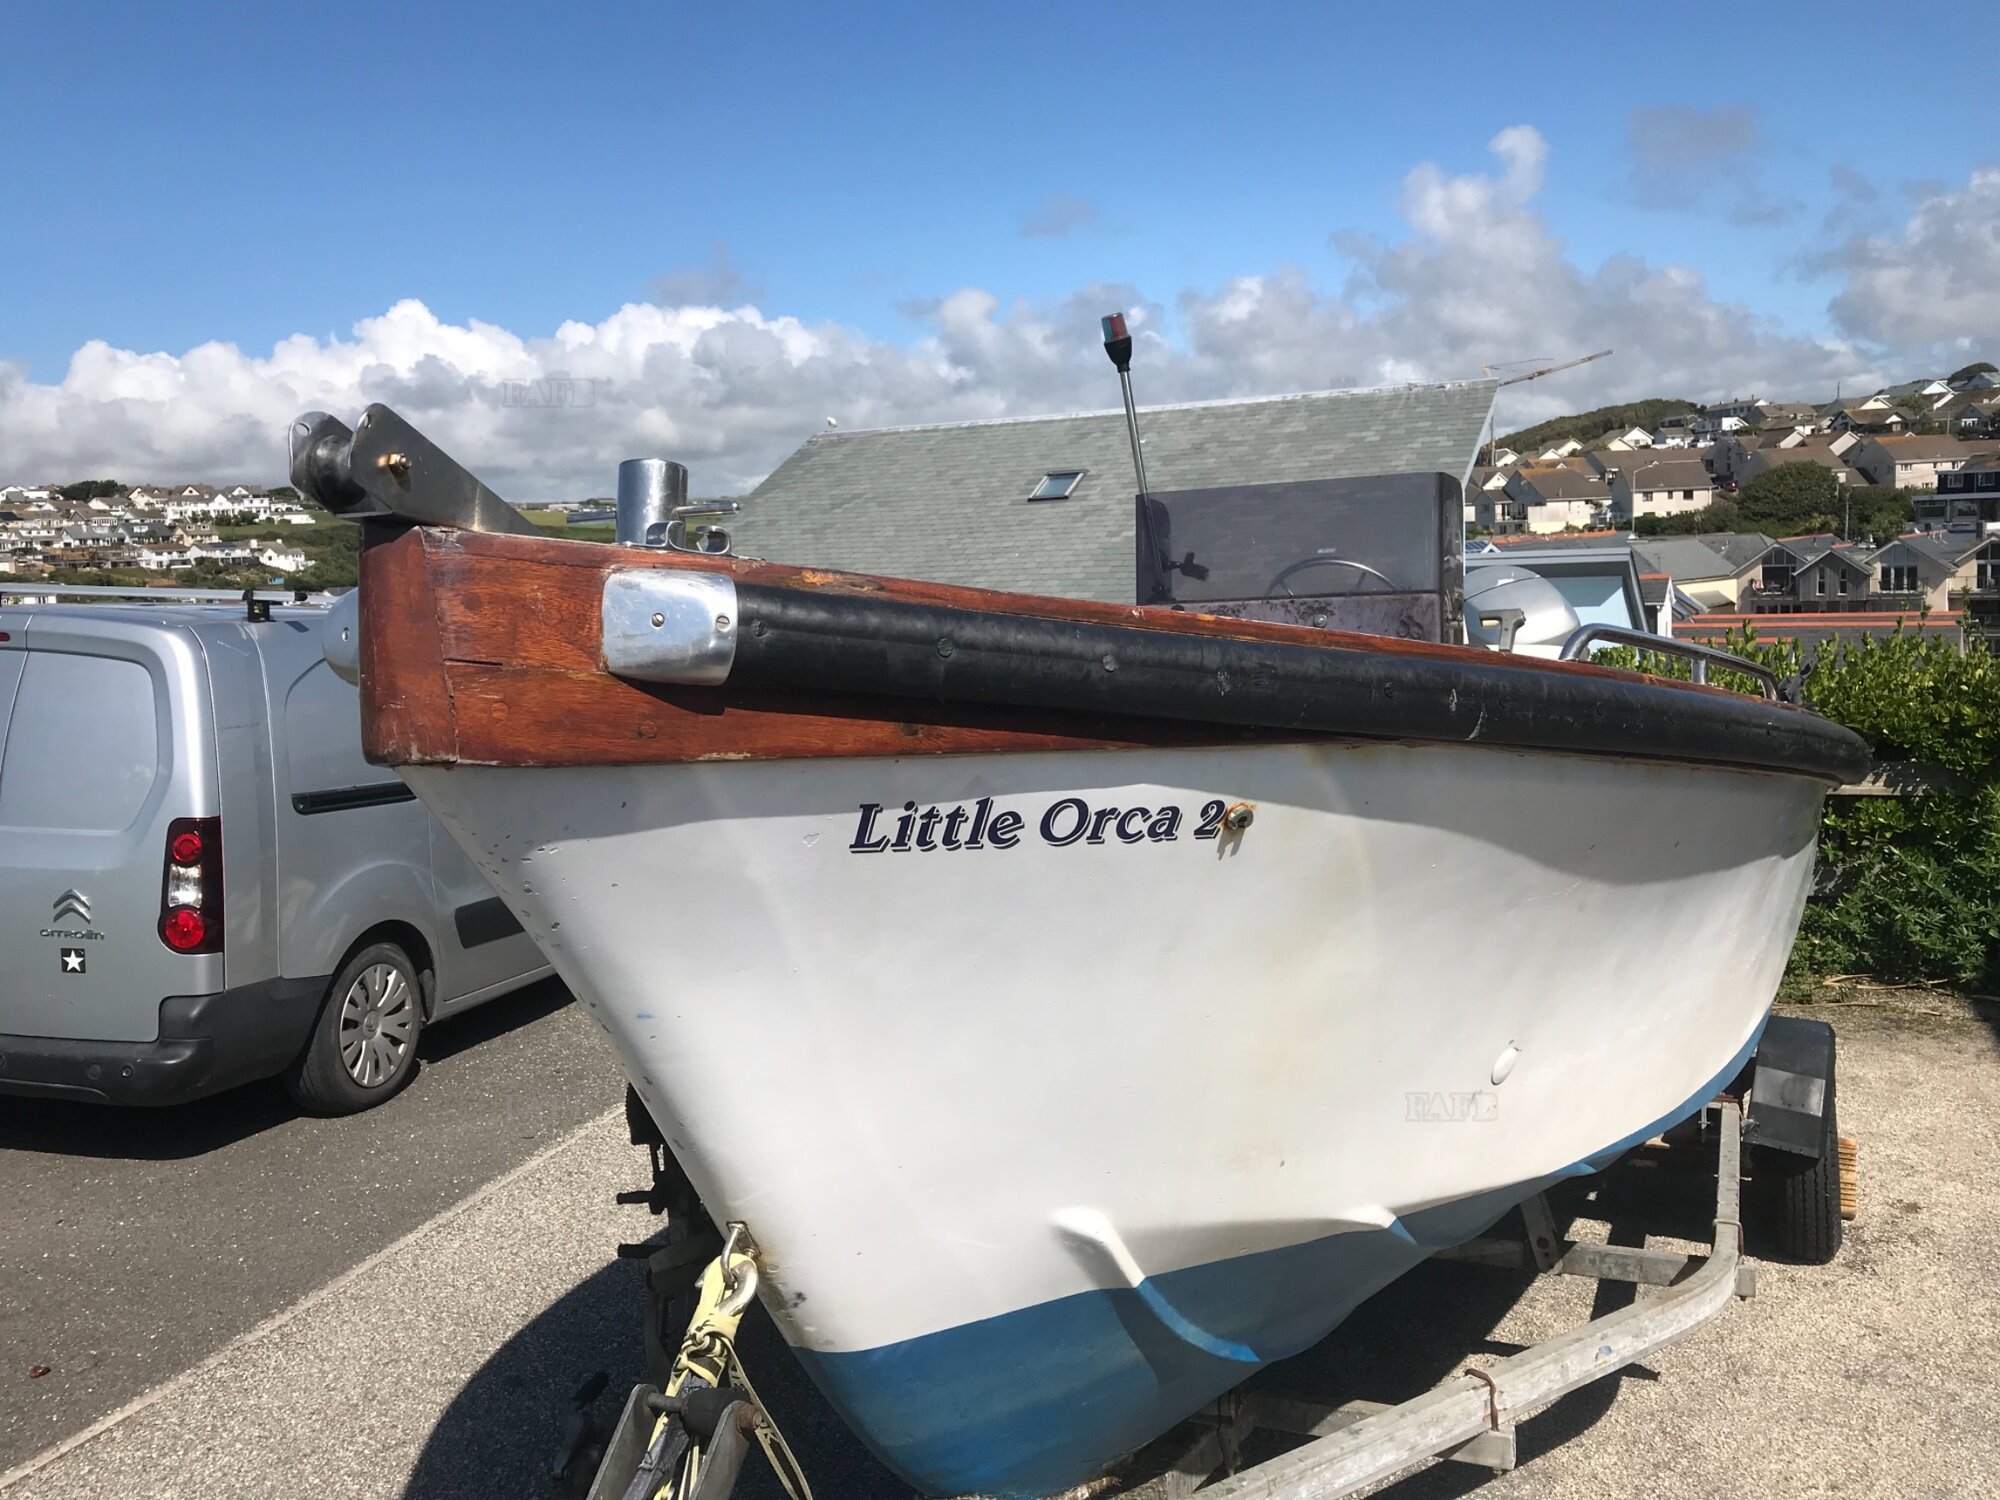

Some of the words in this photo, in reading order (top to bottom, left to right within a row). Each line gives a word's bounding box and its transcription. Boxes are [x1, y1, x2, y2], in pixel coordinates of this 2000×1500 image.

[849, 796, 1025, 855] Little
[1039, 797, 1184, 847] Orca
[1193, 799, 1227, 840] 2
